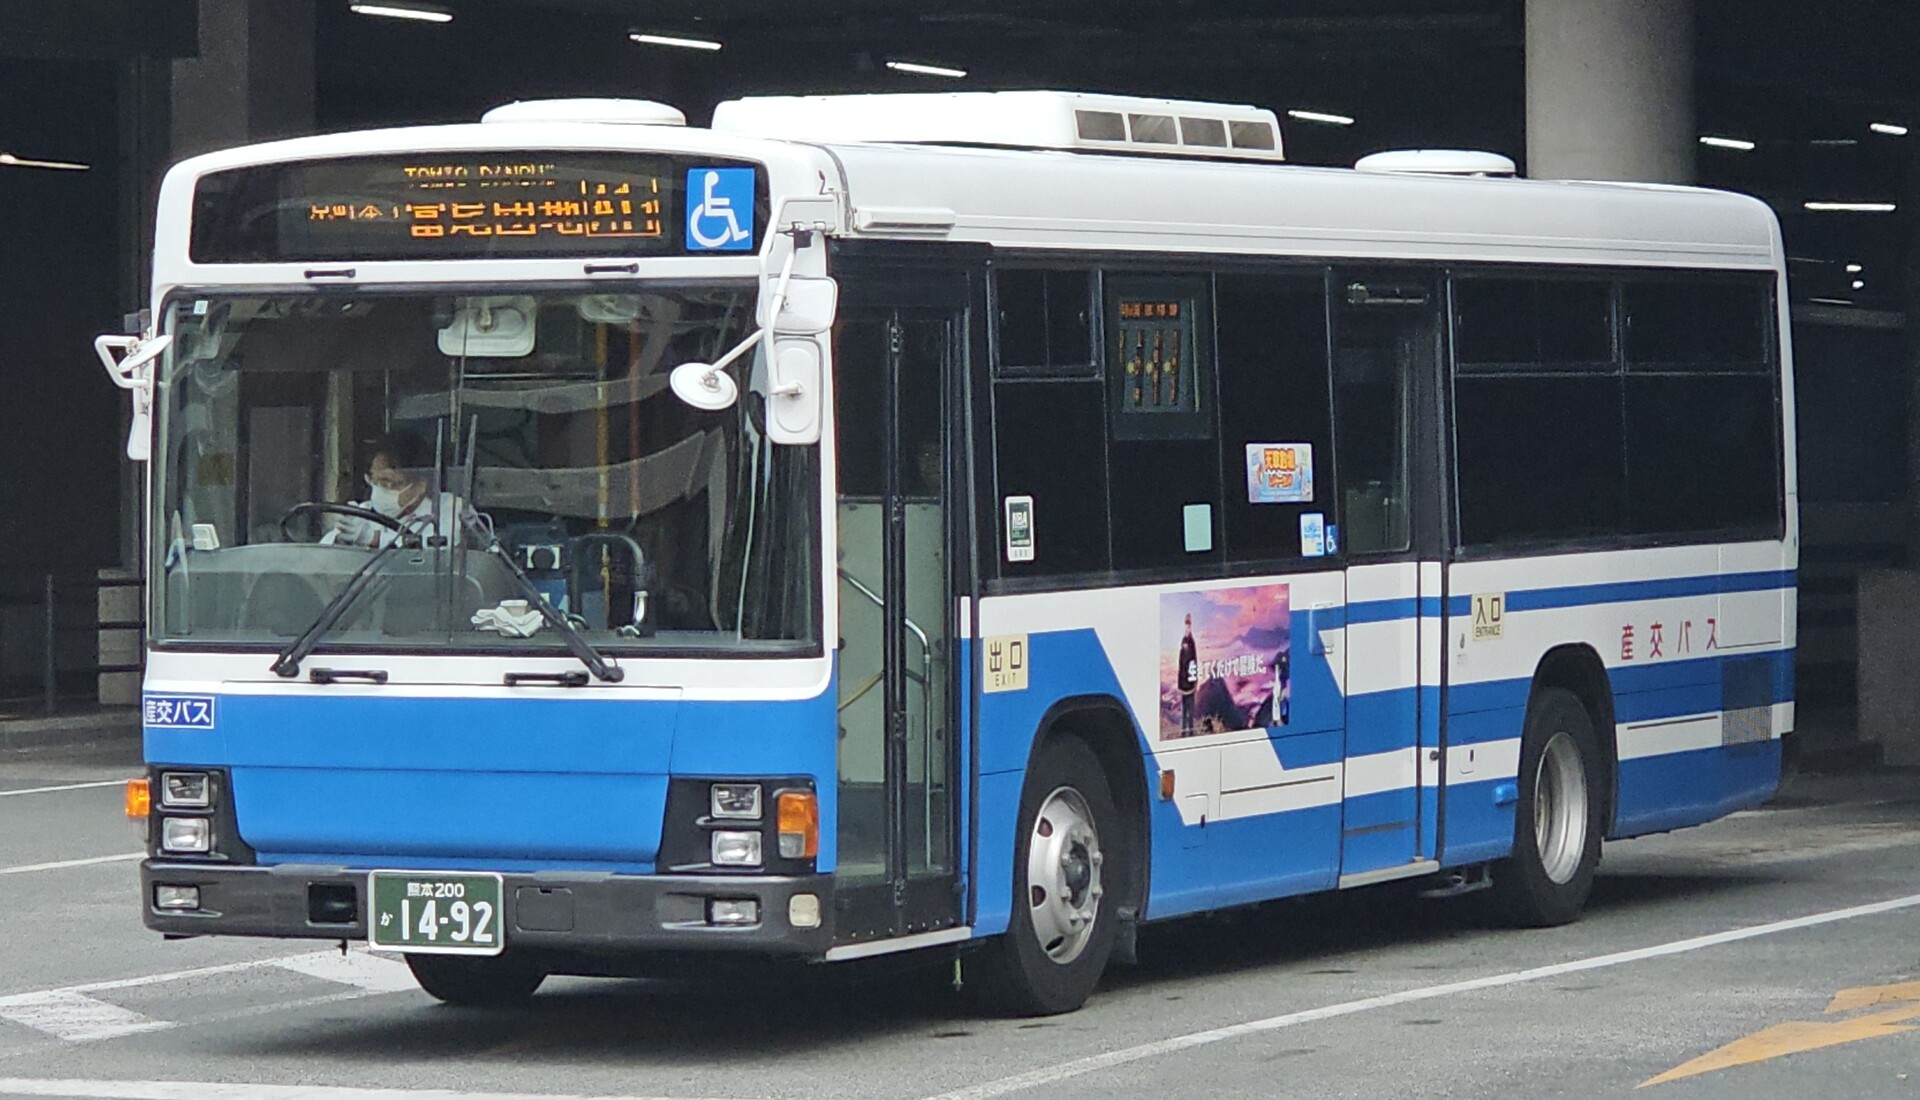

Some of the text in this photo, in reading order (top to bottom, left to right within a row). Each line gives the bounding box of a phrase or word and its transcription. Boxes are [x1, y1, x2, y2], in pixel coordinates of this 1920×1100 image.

[1476, 596, 1501, 625] 入口
[1475, 624, 1501, 637] ENTRANCE
[1620, 616, 1718, 661] 産交バス
[989, 639, 1023, 673] 出口
[995, 672, 1018, 687] EXIT
[380, 899, 493, 943] か 14-92
